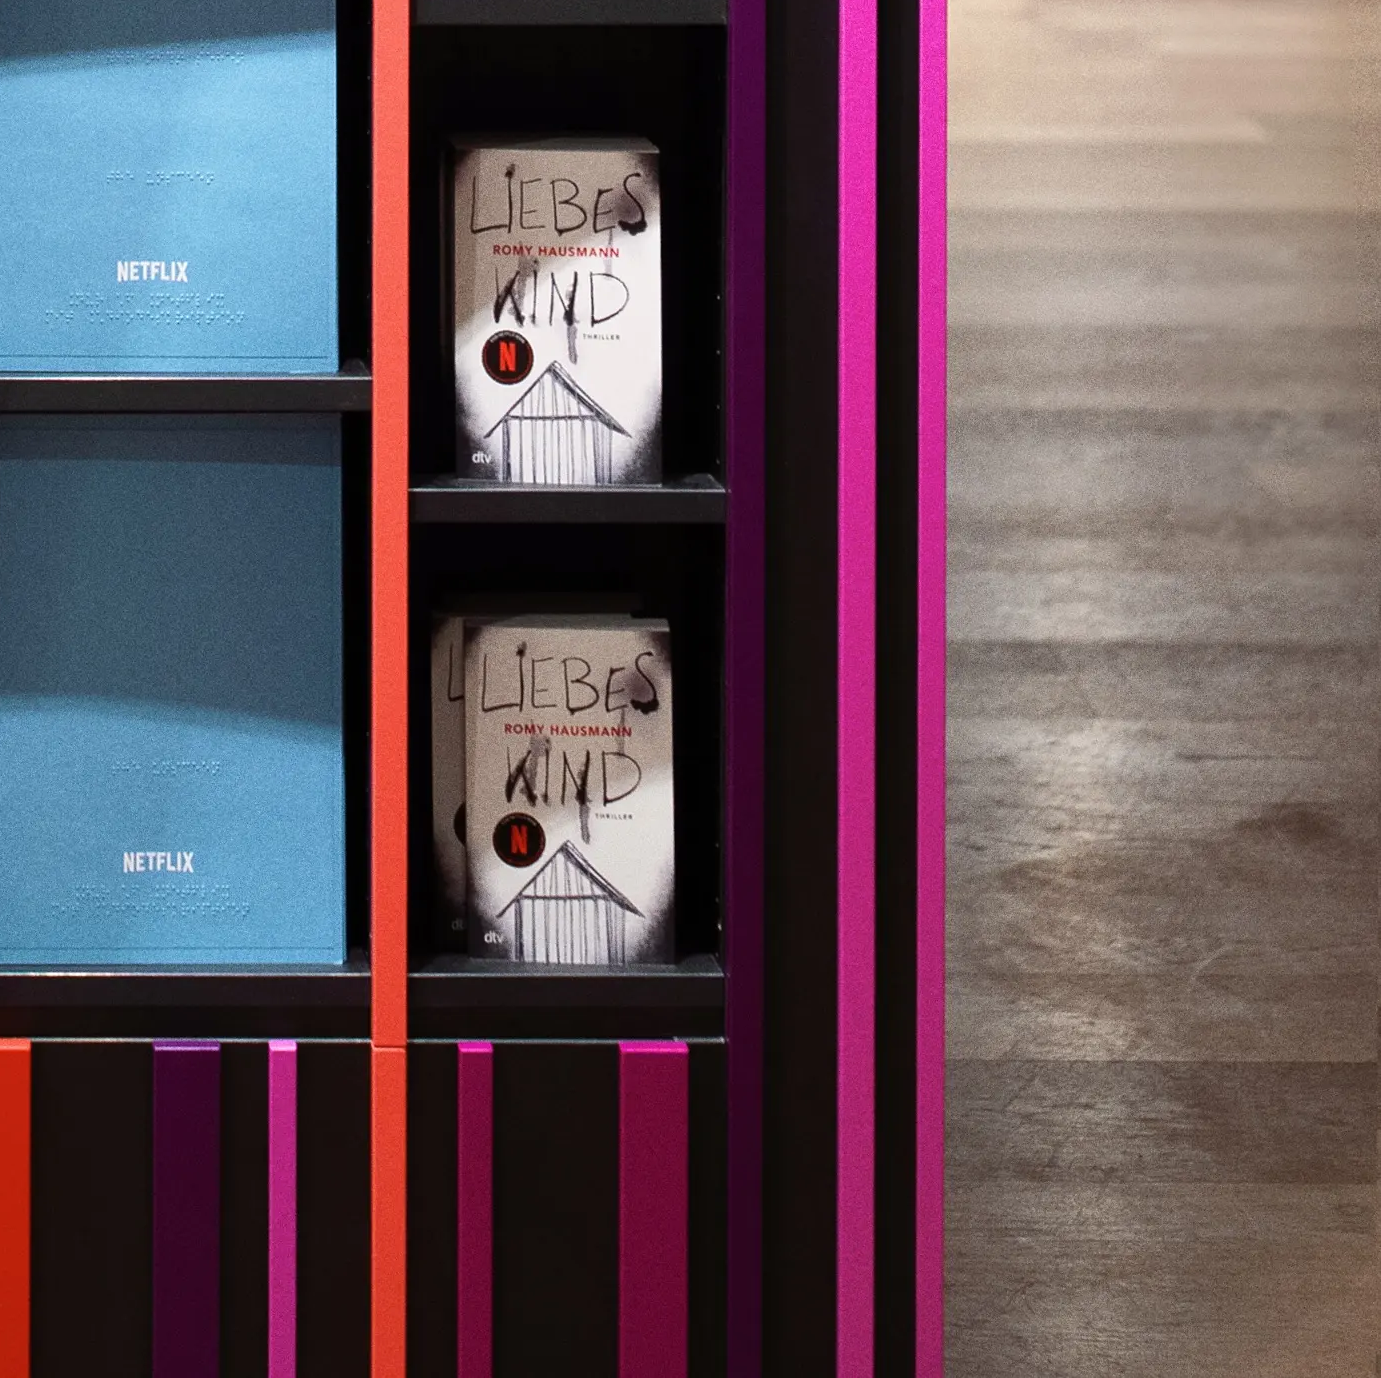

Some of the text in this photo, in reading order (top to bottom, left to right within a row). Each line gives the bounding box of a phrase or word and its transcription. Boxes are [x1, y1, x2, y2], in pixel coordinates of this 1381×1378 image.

[493, 245, 619, 258] ROMY HAUSMANN
[117, 261, 188, 283] NETFLIX
[472, 452, 491, 464] dtv
[504, 723, 632, 737] ROMY HAUSMANN
[123, 852, 193, 873] NETFLIX
[451, 918, 464, 931] dt
[484, 931, 503, 943] dtv
